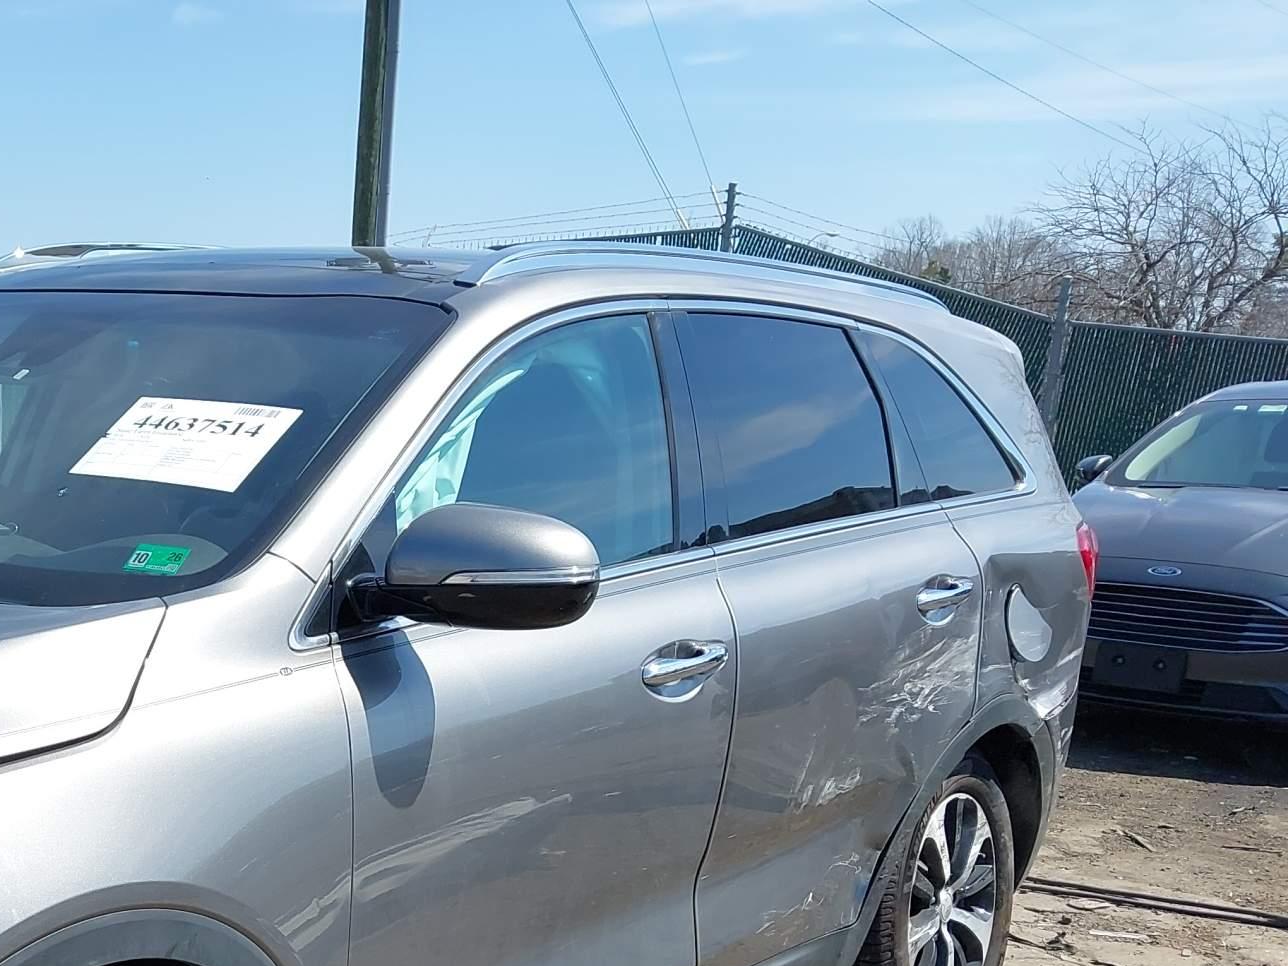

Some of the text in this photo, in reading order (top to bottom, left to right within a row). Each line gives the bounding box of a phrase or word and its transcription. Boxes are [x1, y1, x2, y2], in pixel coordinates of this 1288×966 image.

[133, 414, 266, 438] 44637514
[131, 551, 150, 564] 10
[167, 551, 184, 563] 26
